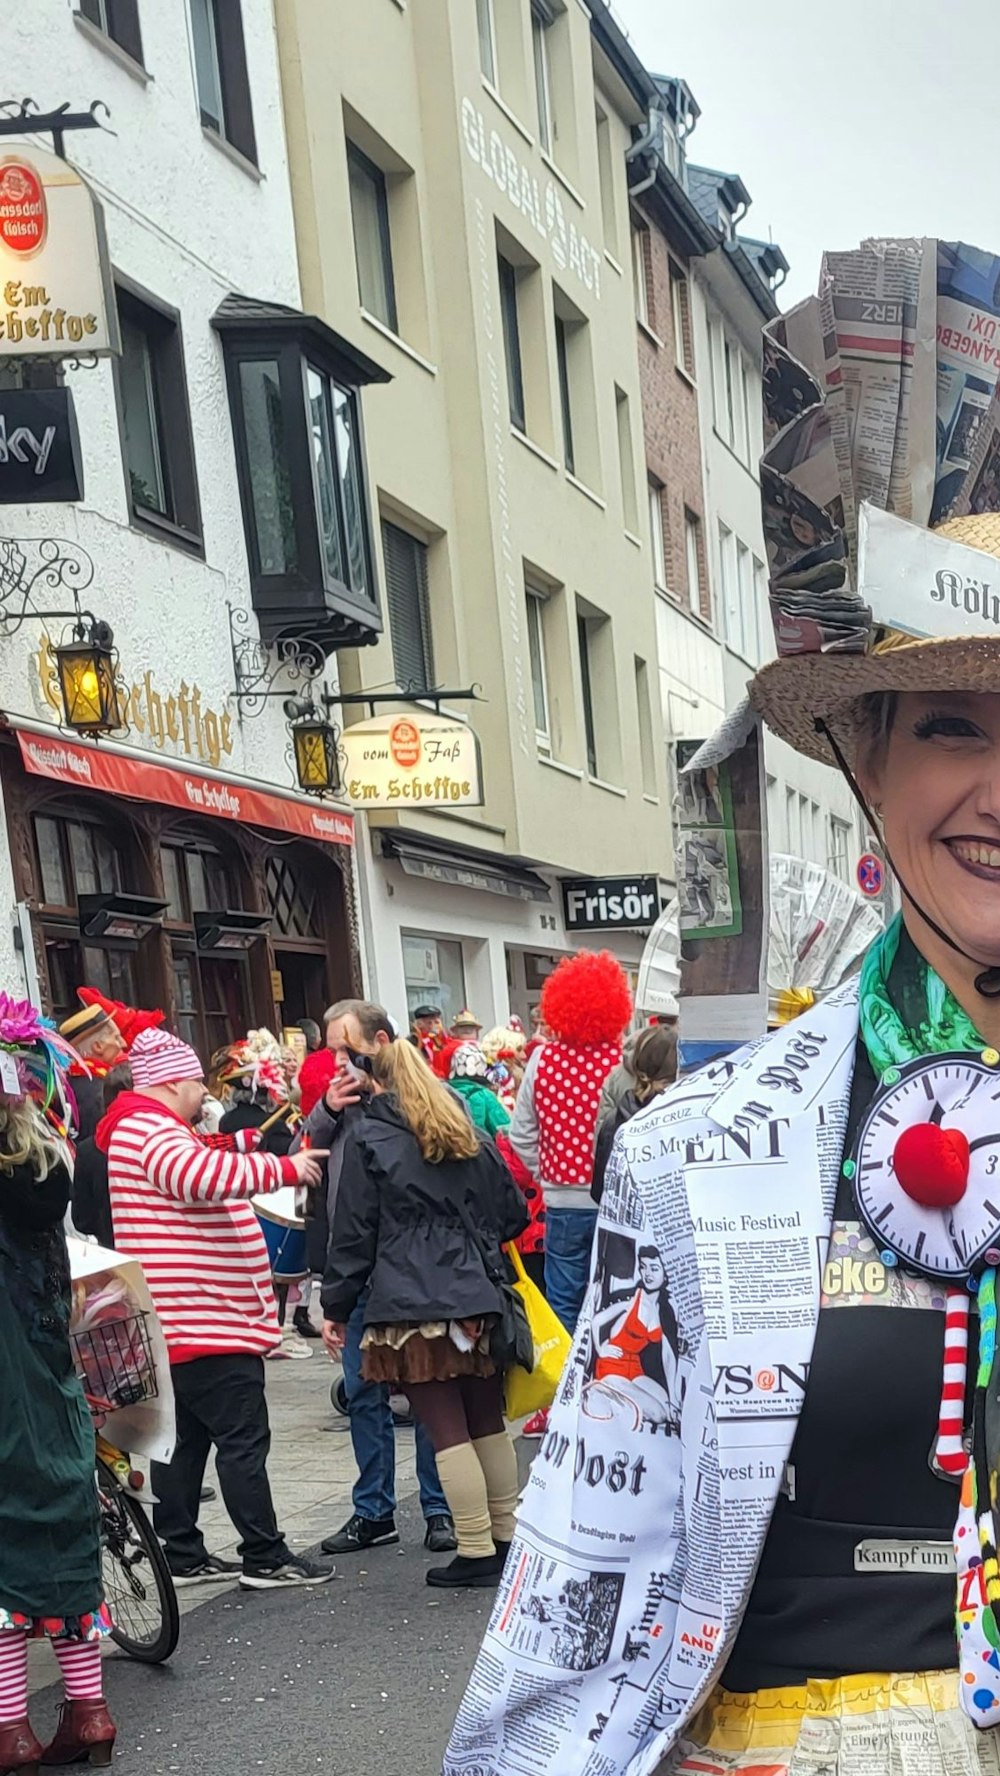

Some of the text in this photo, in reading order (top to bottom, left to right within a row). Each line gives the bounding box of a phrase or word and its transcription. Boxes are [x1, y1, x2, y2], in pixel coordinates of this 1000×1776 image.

[3, 280, 50, 307] Em
[363, 749, 389, 760] vom
[349, 775, 472, 801] Em Scheffge
[566, 886, 655, 923] Frisör
[985, 1154, 999, 1175] 3
[691, 1210, 801, 1232] Music Festival
[758, 1460, 776, 1479] in
[857, 1546, 950, 1567] Kampf um
